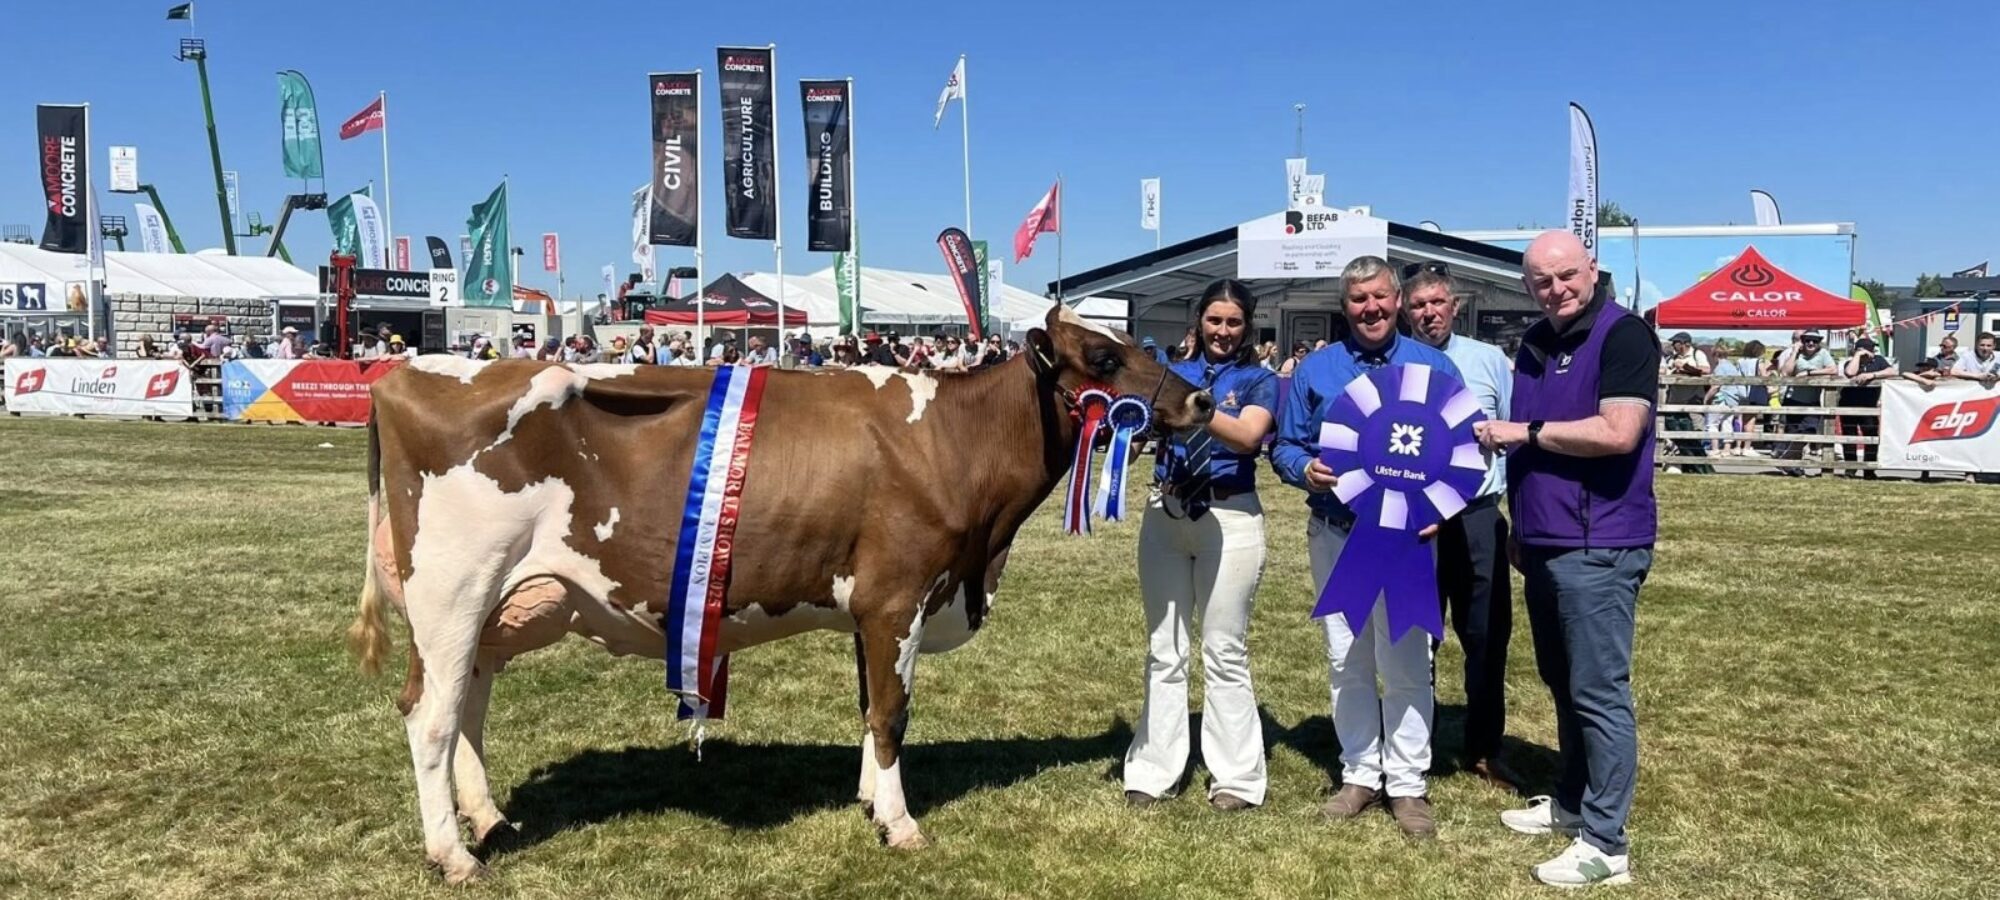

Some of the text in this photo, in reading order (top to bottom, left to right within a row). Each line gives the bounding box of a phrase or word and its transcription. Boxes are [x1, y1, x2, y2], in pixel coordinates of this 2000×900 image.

[724, 64, 765, 72] CONCRETE
[655, 88, 691, 96] CONCRETE
[806, 94, 842, 102] CONCRETE
[741, 97, 755, 199] AGRICULTURE
[44, 135, 61, 192] MOORE
[663, 135, 681, 190] CIVIL
[820, 132, 833, 211] BUILDING
[61, 136, 76, 217] CONCRETE
[1306, 213, 1338, 222] BEFAB
[1571, 198, 1585, 242] arlon
[1583, 218, 1593, 250] CST
[946, 234, 968, 274] CONCRETE
[385, 277, 429, 292] CONCR
[432, 273, 455, 283] RING
[439, 287, 448, 302] 2
[1710, 291, 1803, 302] CALOR
[1747, 309, 1787, 317] CALOR
[71, 377, 116, 394] Linden
[1930, 401, 1979, 436] abp
[1375, 465, 1426, 481] Ulster Bank
[713, 518, 736, 572] SHOW
[708, 573, 726, 608] 2025
